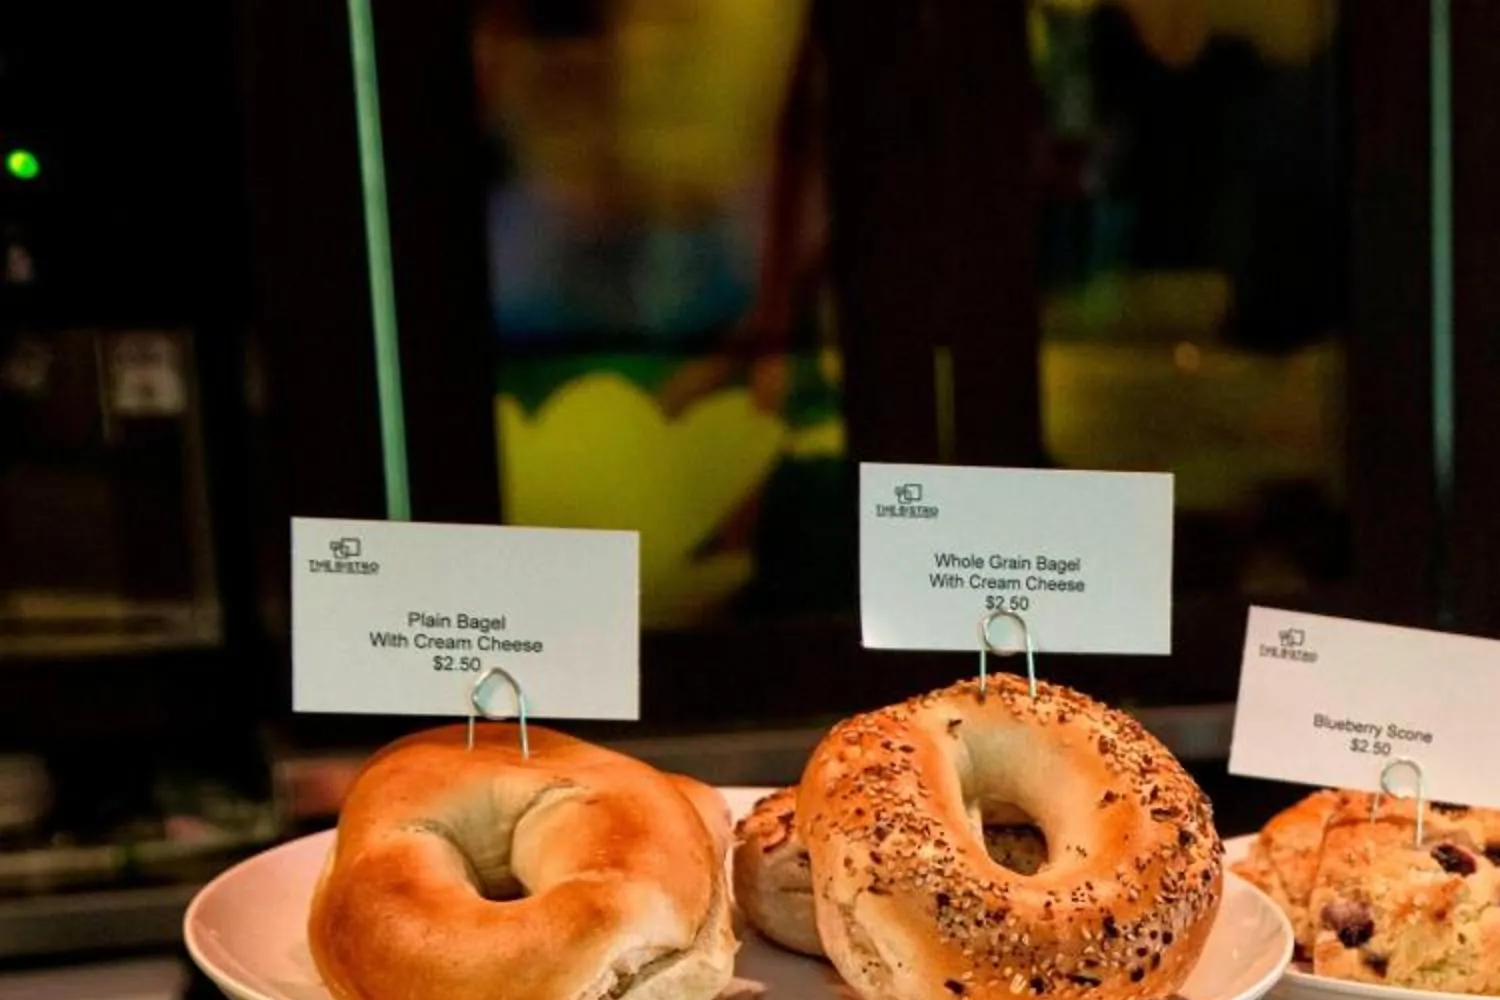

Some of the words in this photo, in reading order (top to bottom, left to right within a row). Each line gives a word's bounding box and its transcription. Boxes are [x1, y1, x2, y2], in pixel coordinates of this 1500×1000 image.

[934, 553, 984, 569] Whole
[989, 554, 1031, 570] Grain
[1036, 556, 1081, 574] Bagel
[929, 574, 964, 589] With
[969, 575, 1021, 590] Cream
[1026, 576, 1085, 592] Cheese
[408, 611, 451, 628] Plain
[457, 613, 506, 631] Bagel
[370, 631, 408, 649] With
[414, 633, 471, 650] Cream
[478, 635, 543, 653] Cheese
[433, 655, 481, 672] $2.50
[1313, 713, 1382, 739] Blueberry
[1387, 723, 1433, 744] Scone
[1349, 738, 1391, 756] $2.50
